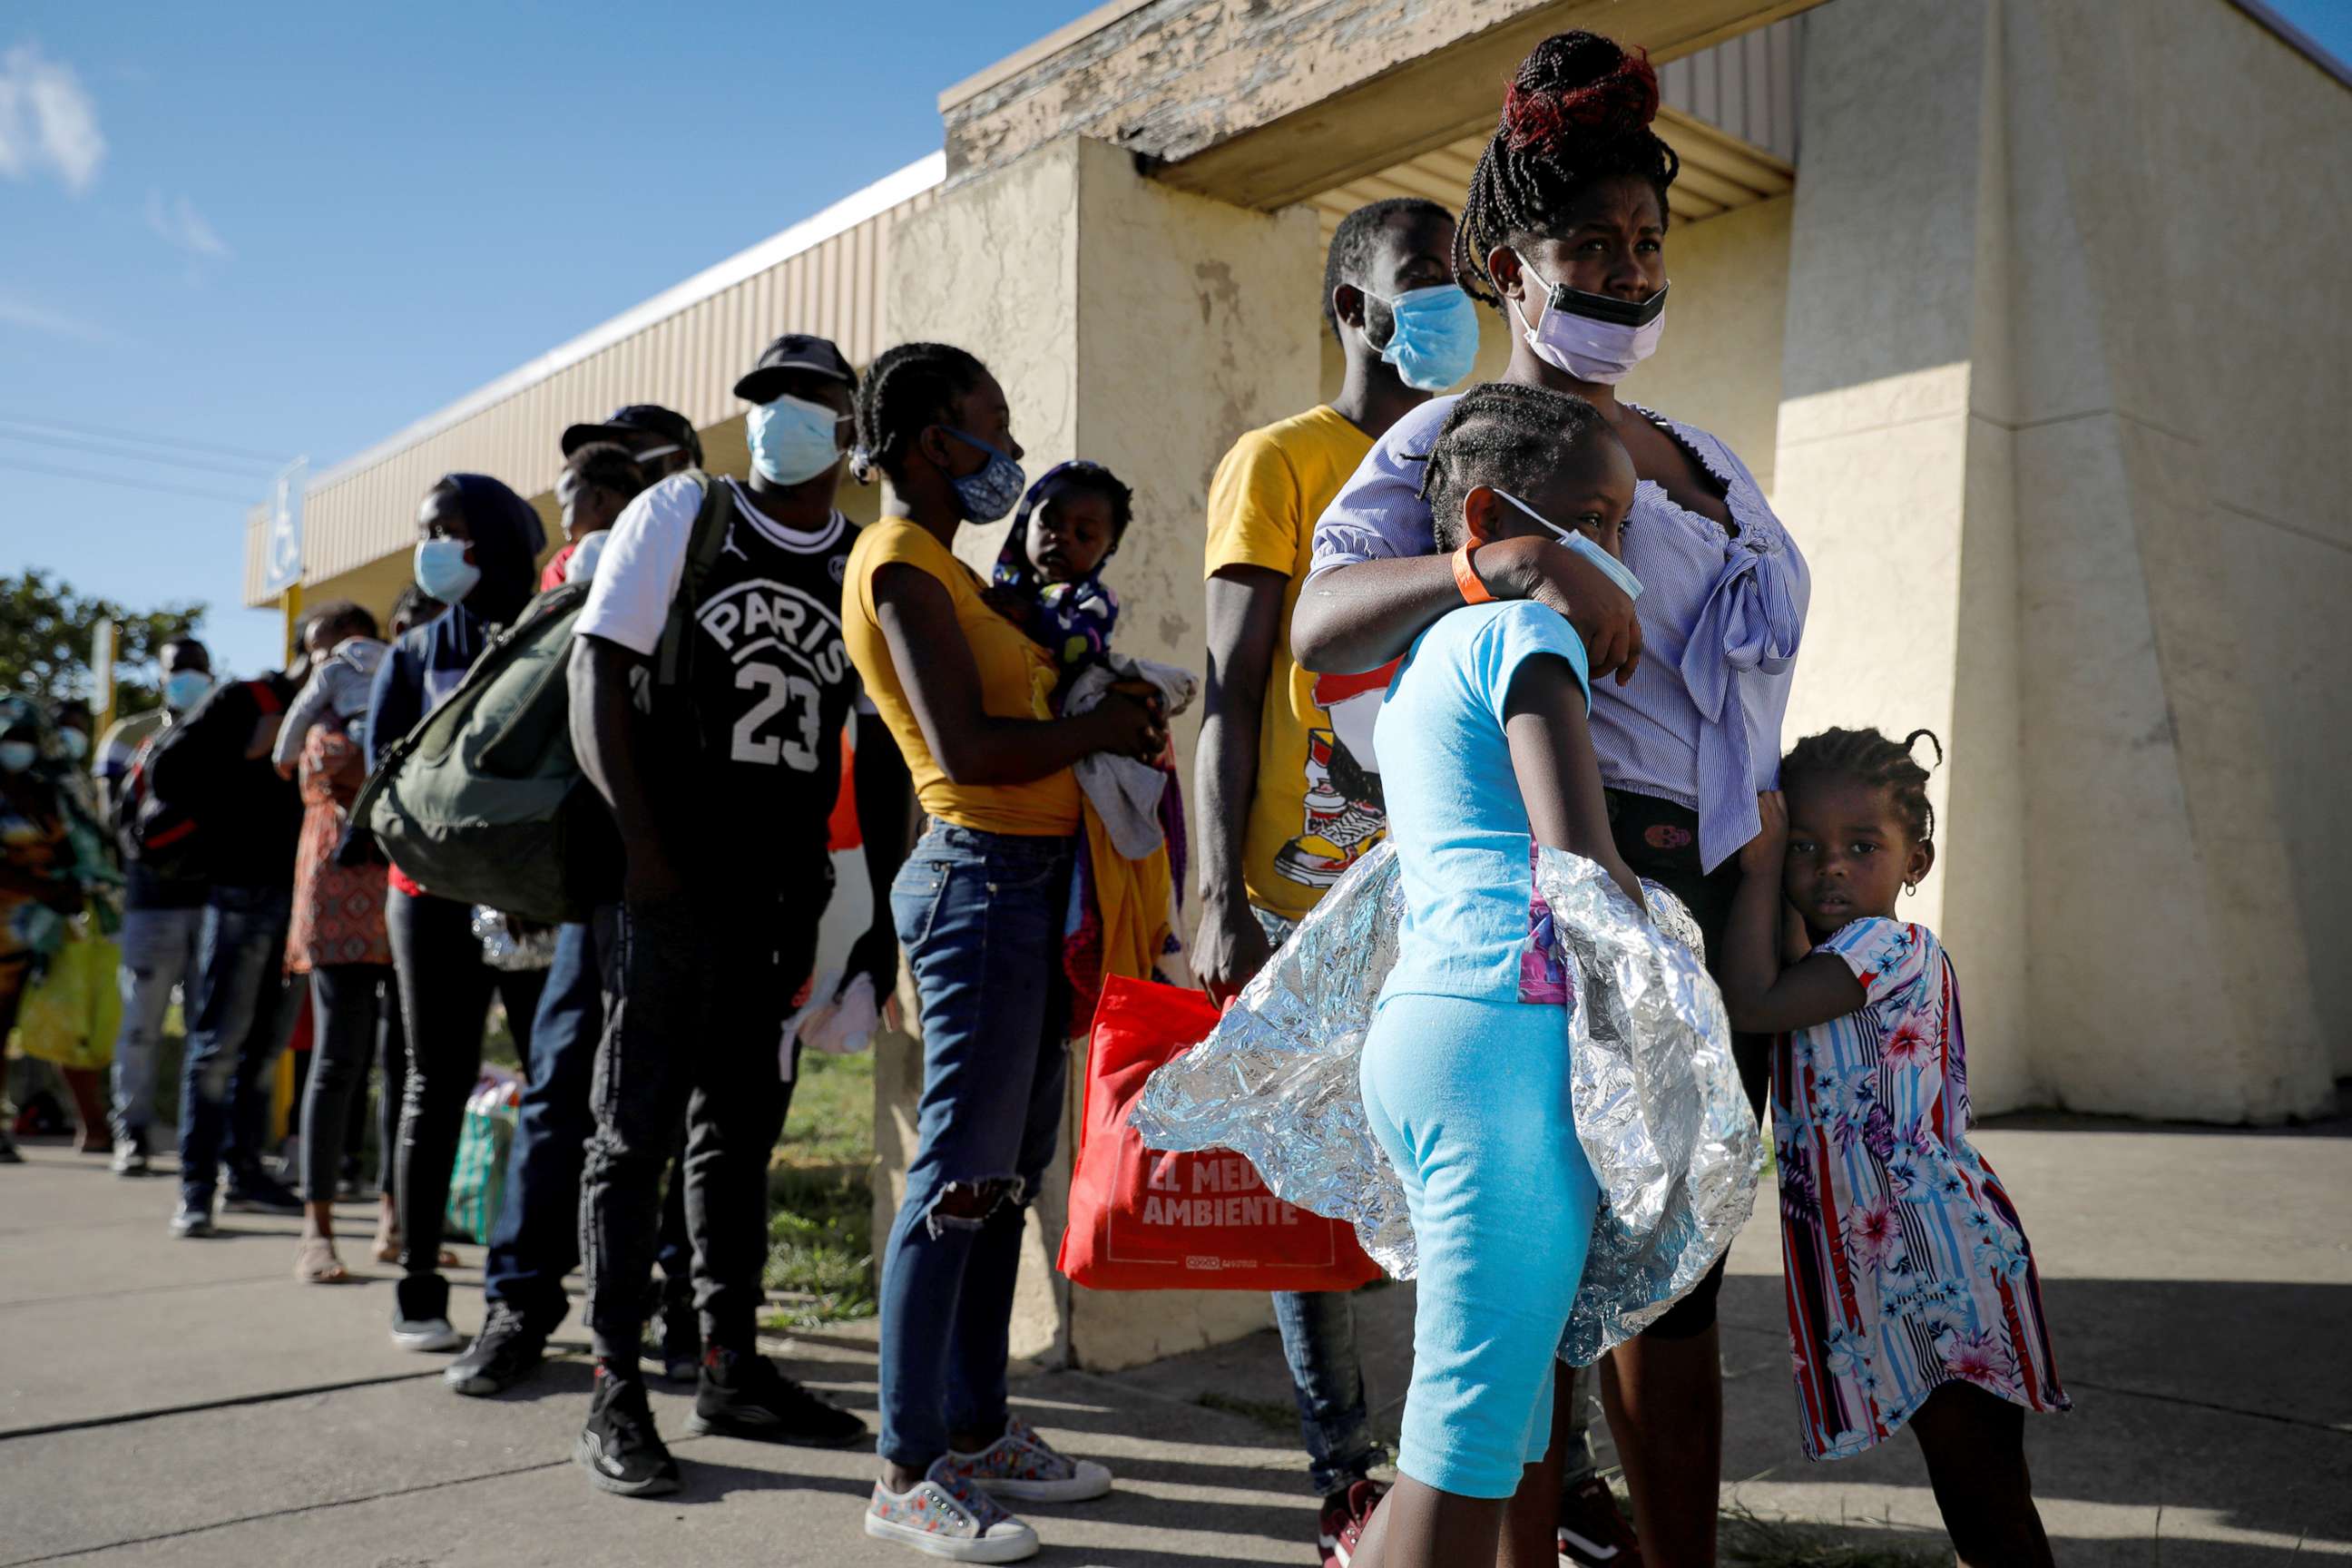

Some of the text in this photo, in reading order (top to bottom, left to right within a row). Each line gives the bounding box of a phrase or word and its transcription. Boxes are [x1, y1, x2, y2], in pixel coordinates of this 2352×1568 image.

[701, 592, 851, 684] PARIS
[731, 662, 820, 772] 23
[1148, 1156, 1262, 1194] EL MED
[1142, 1196, 1298, 1227] AMBIENTE
